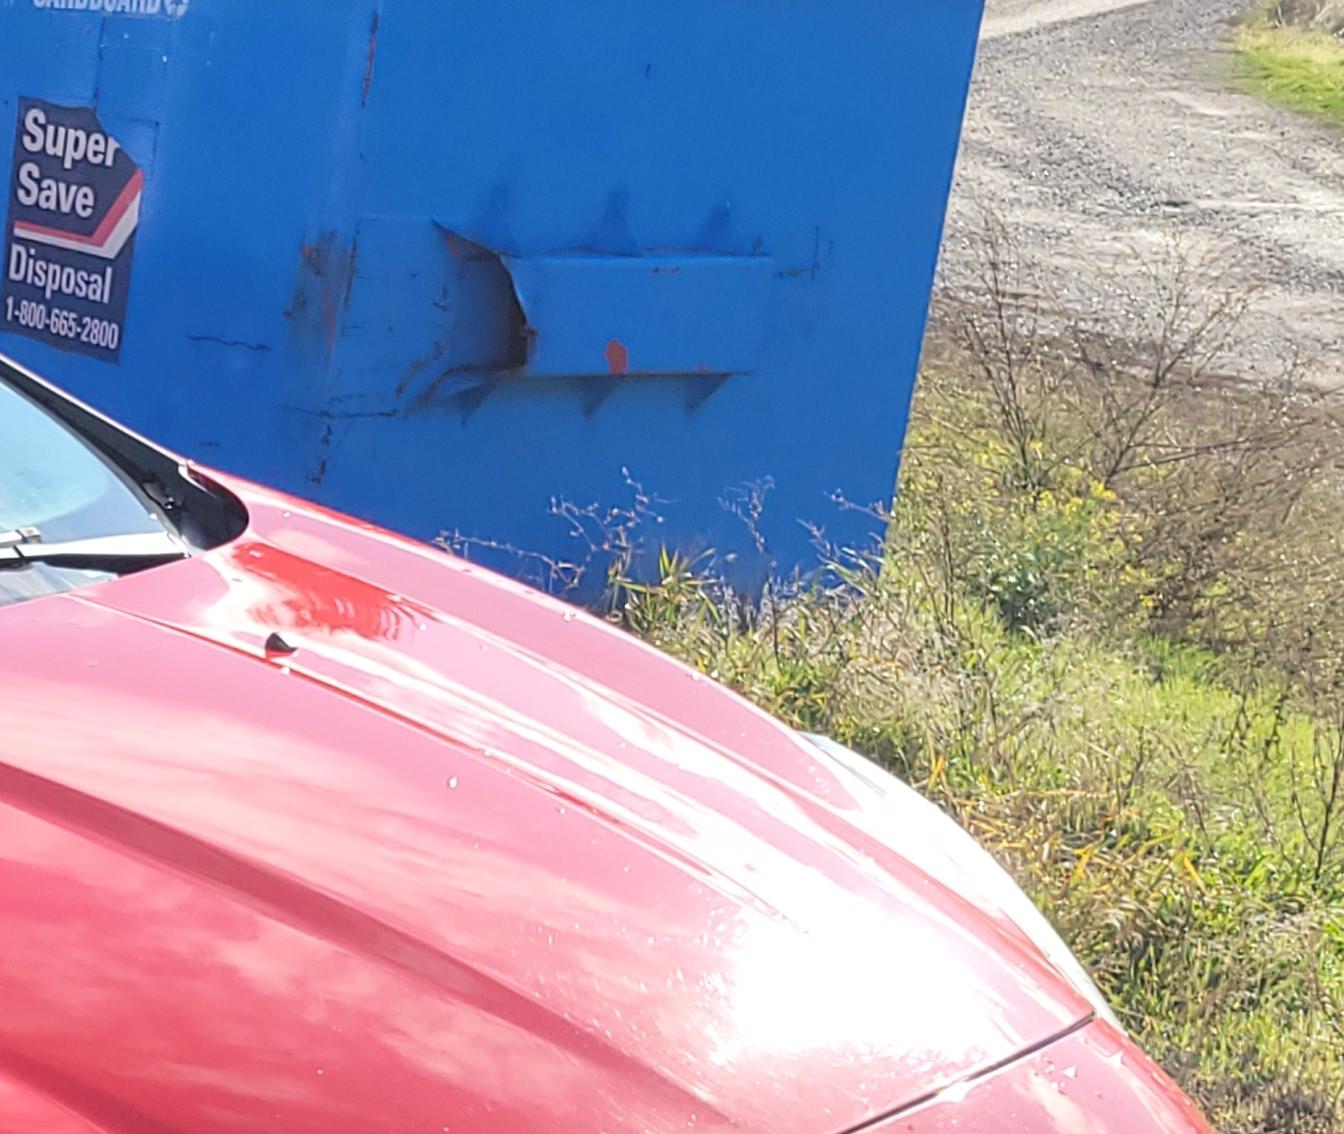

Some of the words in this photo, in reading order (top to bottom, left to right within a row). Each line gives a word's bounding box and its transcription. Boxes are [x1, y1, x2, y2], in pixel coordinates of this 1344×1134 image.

[21, 108, 121, 169] Super
[17, 162, 94, 218] Save
[8, 243, 112, 303] Disposal
[6, 296, 120, 350] 1-800-665-2800
